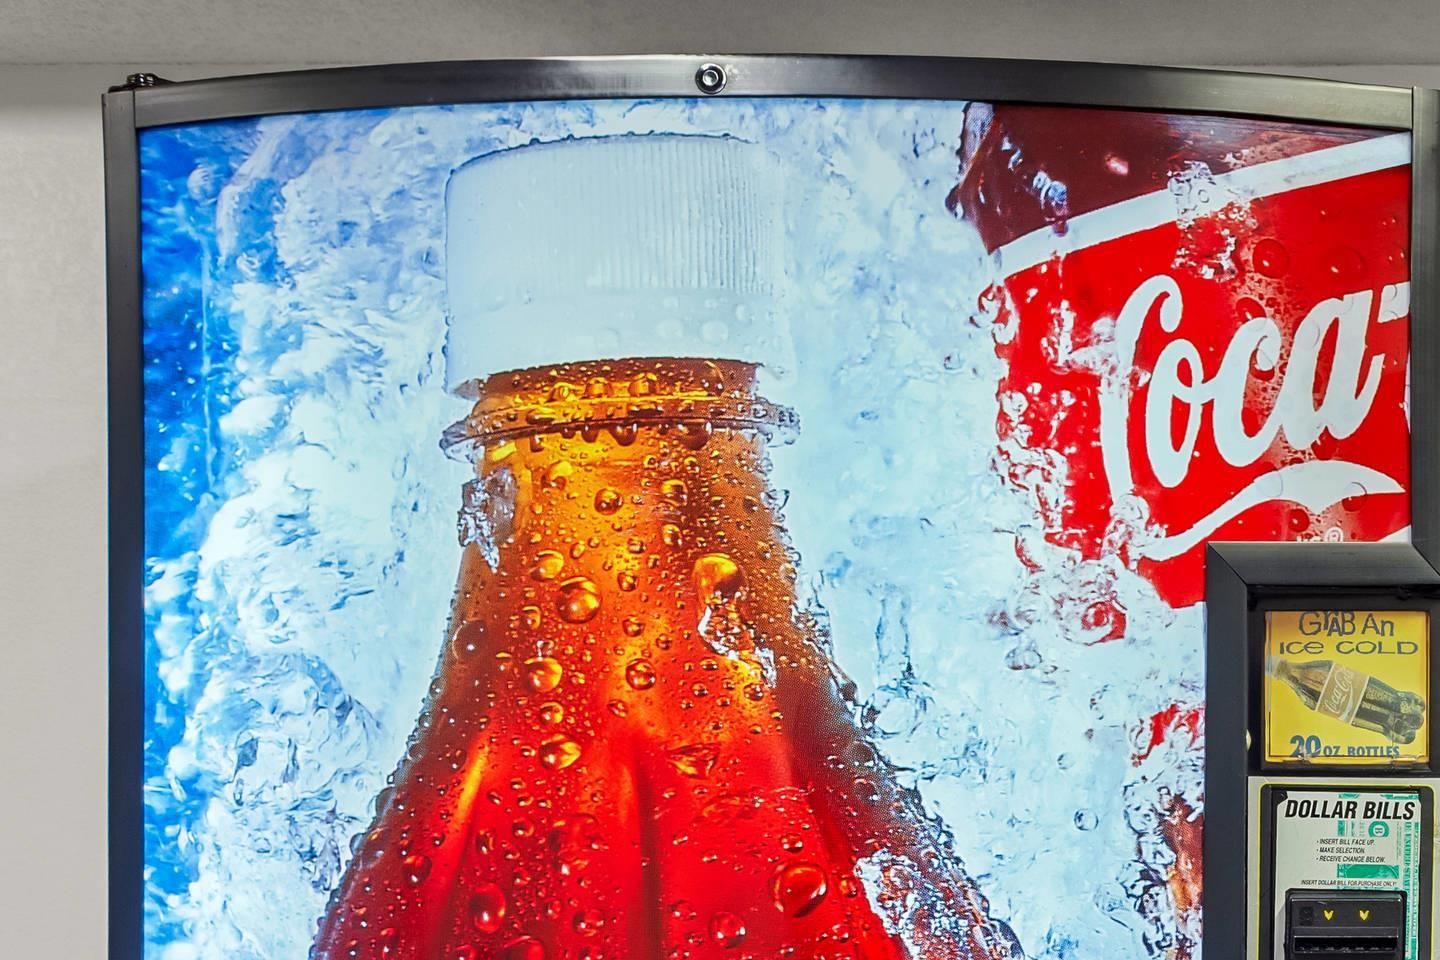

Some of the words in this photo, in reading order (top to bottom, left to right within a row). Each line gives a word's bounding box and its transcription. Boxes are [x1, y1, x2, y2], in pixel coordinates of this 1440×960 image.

[1361, 613, 1394, 636] An
[1336, 641, 1418, 655] COLD
[1290, 735, 1322, 757] 20
[1348, 745, 1400, 758] BOTTLES
[1285, 800, 1357, 819] DOLLAR
[1363, 801, 1415, 820] BILLS
[1319, 855, 1341, 863] RECEIVE
